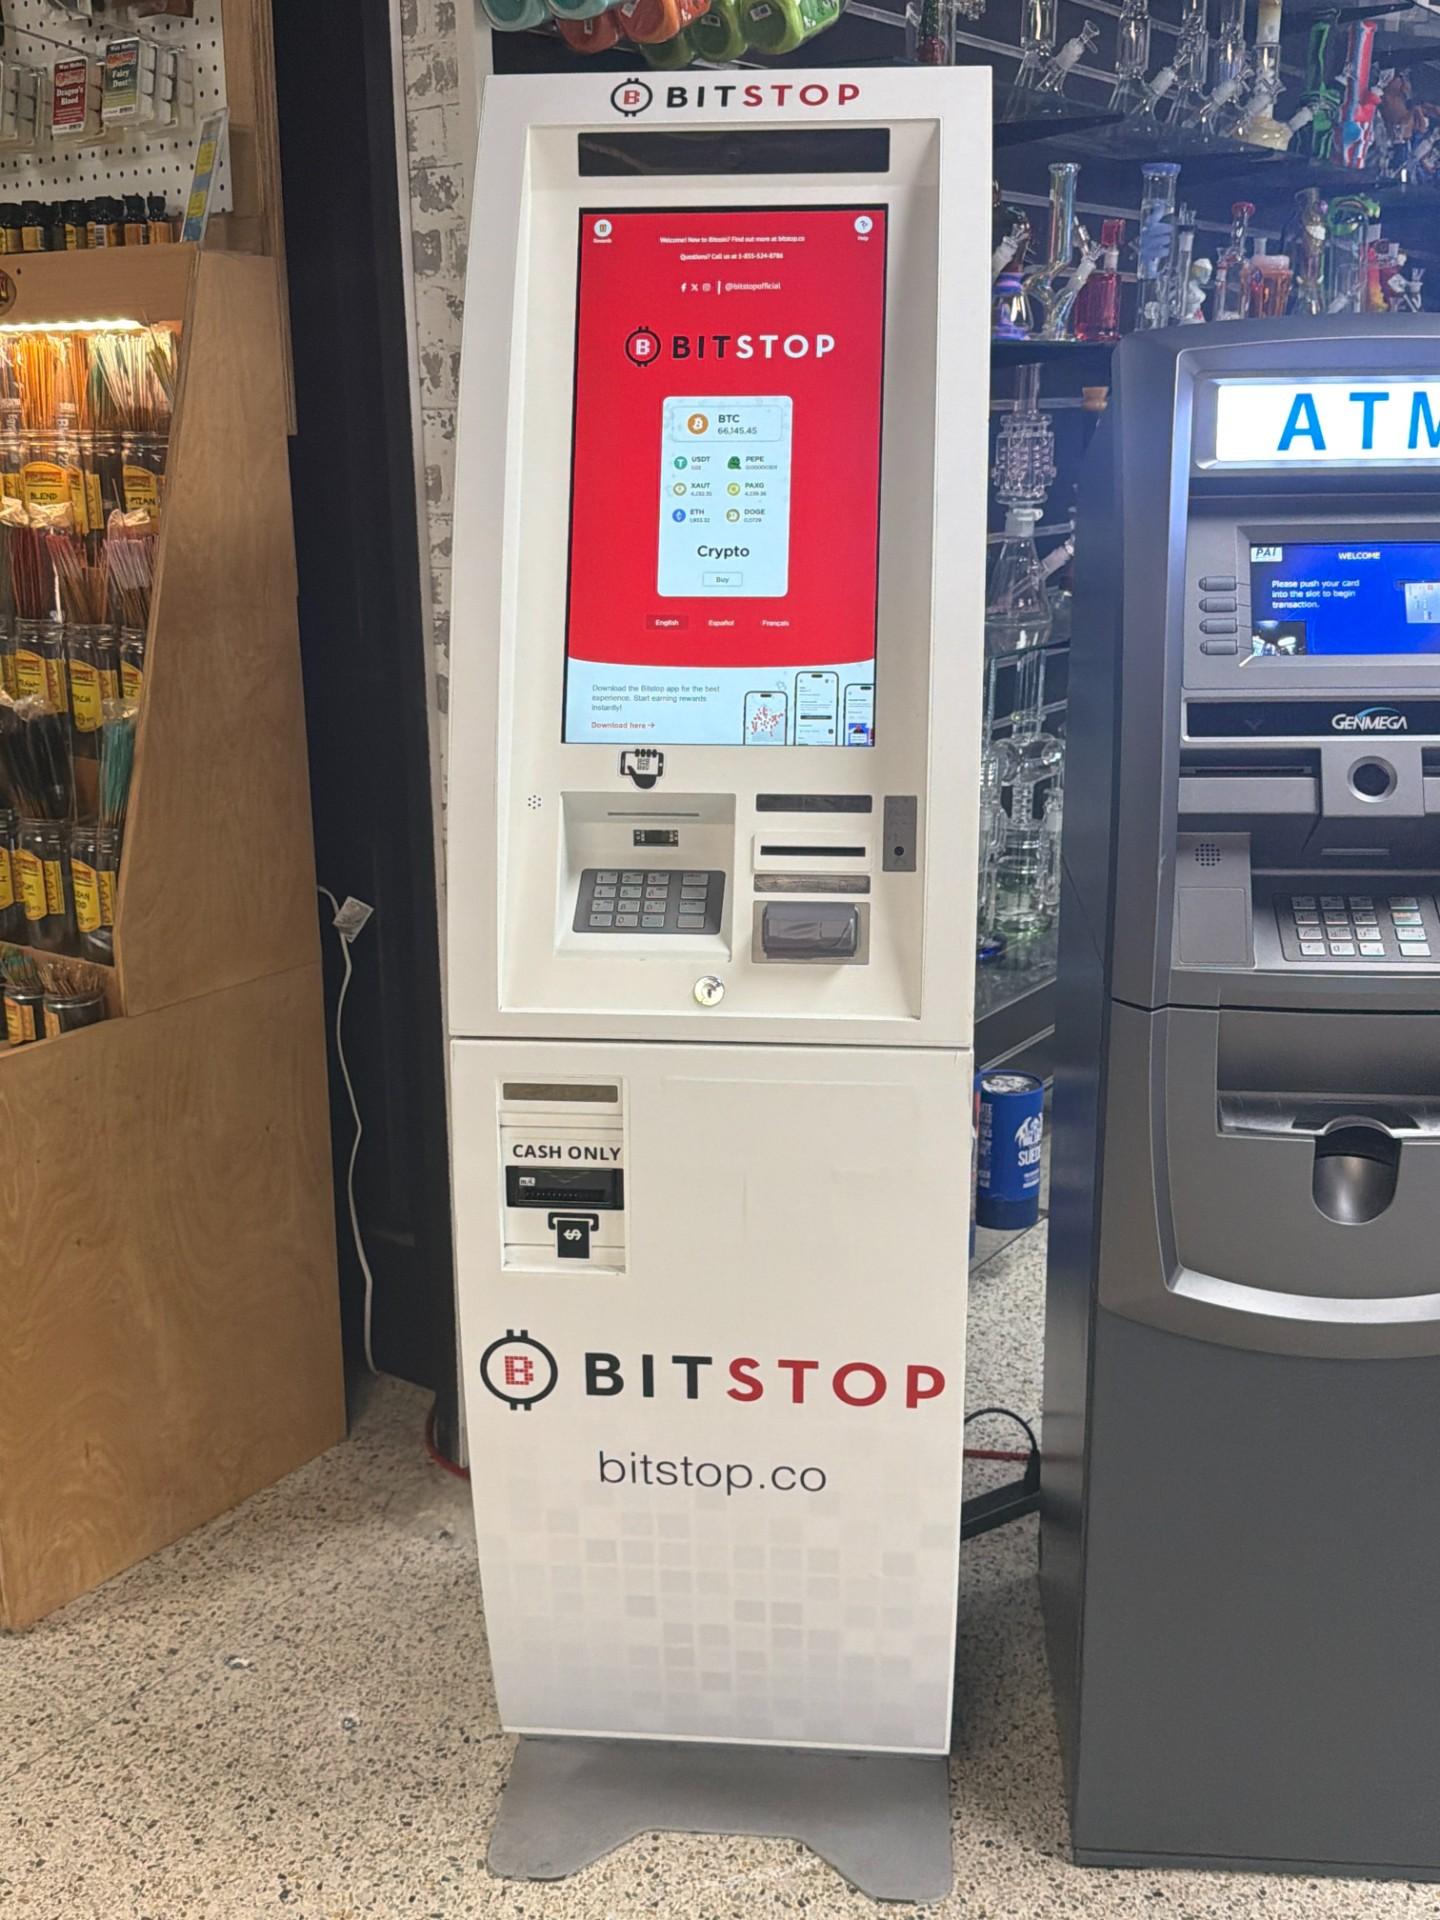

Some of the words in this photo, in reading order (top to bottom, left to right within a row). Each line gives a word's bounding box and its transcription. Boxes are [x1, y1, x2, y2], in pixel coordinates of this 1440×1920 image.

[112, 70, 129, 78] Fairy
[113, 80, 128, 88] Dust
[56, 86, 83, 97] Dragon's
[666, 84, 860, 108] BITSTOP
[61, 96, 78, 106] Blood
[724, 282, 781, 291] @bitstopofficial
[672, 334, 835, 359] BITSTOP
[718, 414, 740, 423] BTC
[1276, 391, 1440, 451] ATM
[717, 427, 758, 436] 66,145.45
[30, 492, 57, 500] BLEND
[697, 545, 750, 559] Crypto
[1338, 552, 1381, 560] WELCOME
[715, 576, 730, 584] Buy
[1271, 580, 1298, 588] Please
[1300, 580, 1320, 589] push
[1321, 581, 1340, 589] your
[1341, 579, 1360, 587] card
[1272, 590, 1288, 598] into
[1290, 590, 1304, 598] the
[1305, 589, 1321, 598] slot
[1332, 589, 1356, 599] begin
[655, 619, 679, 627] English
[708, 619, 735, 627] Español
[761, 619, 790, 628] Français
[592, 684, 627, 692] Download
[640, 685, 665, 694] Bitstop
[666, 686, 680, 694] app
[591, 694, 631, 703] experience.
[651, 695, 677, 703] earning
[591, 704, 622, 712] instantly!
[591, 721, 628, 729] Download
[1331, 713, 1408, 731] GENMEGA
[512, 1144, 562, 1159] CASH
[568, 1146, 621, 1161] ONLY
[584, 1352, 946, 1409] BITSTOP
[599, 1451, 826, 1495] bitstop.co
